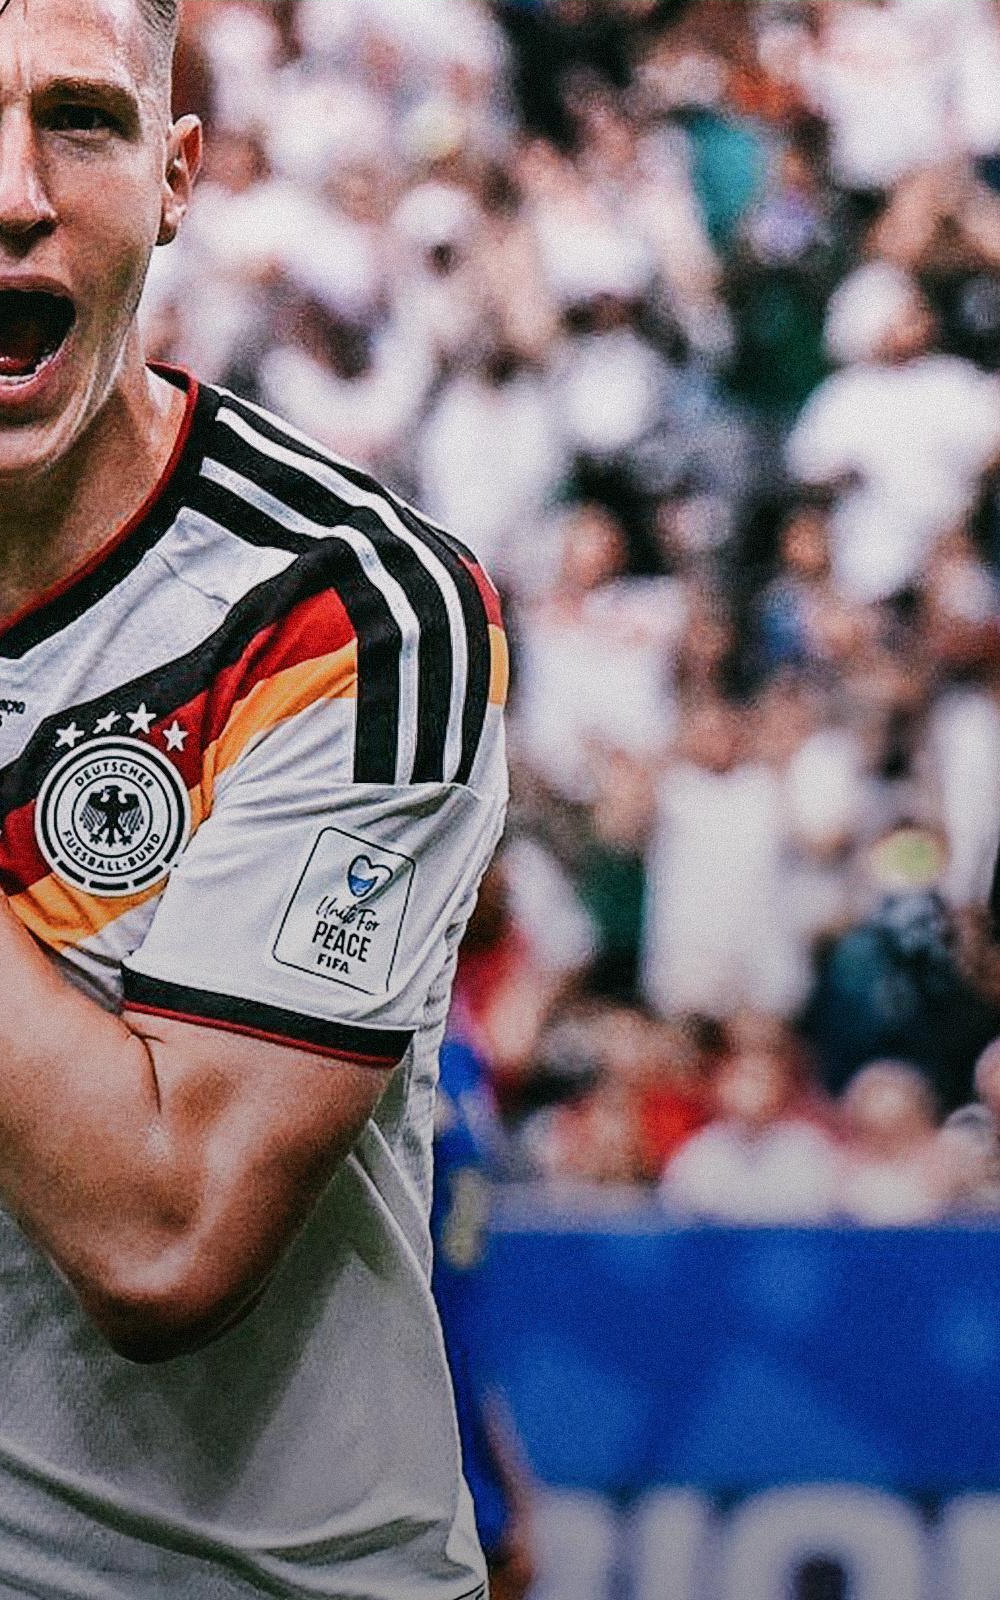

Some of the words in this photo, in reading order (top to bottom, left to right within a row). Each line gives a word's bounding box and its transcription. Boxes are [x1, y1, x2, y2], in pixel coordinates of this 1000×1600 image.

[74, 761, 156, 790] DEUTSCHER
[356, 908, 381, 932] For
[312, 920, 372, 963] PEACE
[317, 953, 350, 974] FIFA
